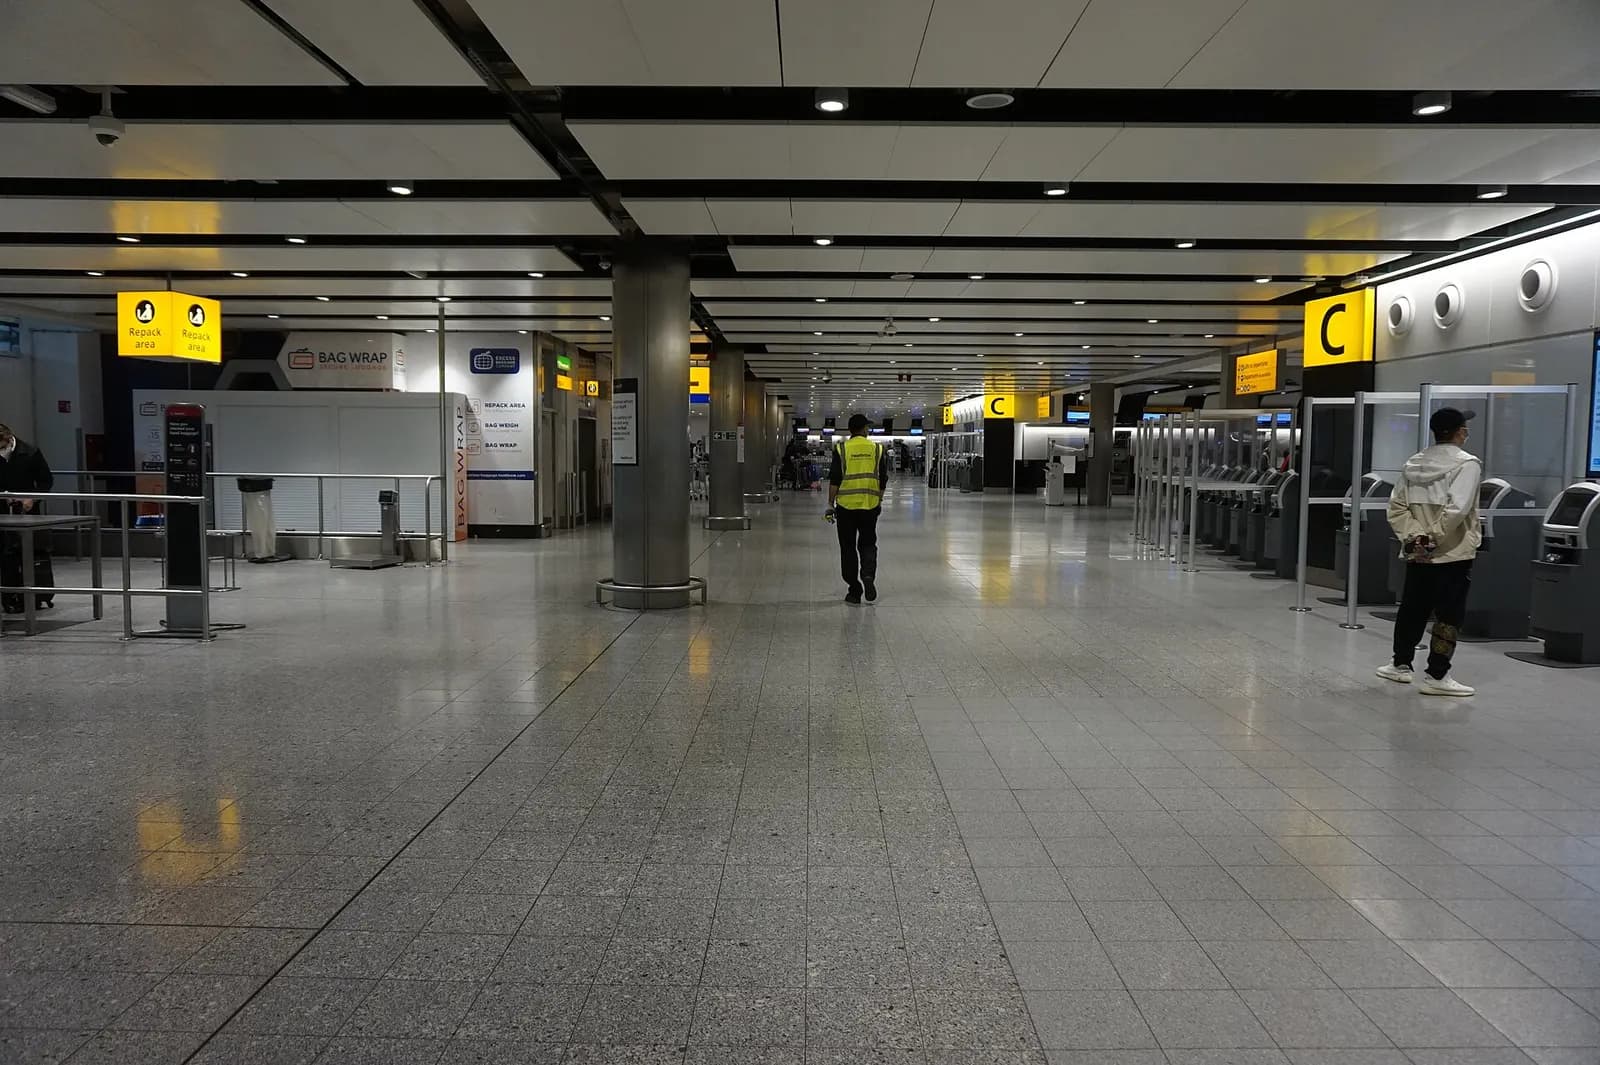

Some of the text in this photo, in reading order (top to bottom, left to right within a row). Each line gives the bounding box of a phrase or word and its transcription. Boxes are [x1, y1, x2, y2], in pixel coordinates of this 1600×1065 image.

[129, 327, 162, 338] Repack
[182, 329, 211, 342] Repack
[1320, 303, 1346, 356] C
[135, 340, 156, 349] area
[187, 342, 206, 352] area
[318, 352, 388, 363] BAG WRAP
[990, 397, 1005, 415] C
[456, 406, 465, 526] BAG WRAP
